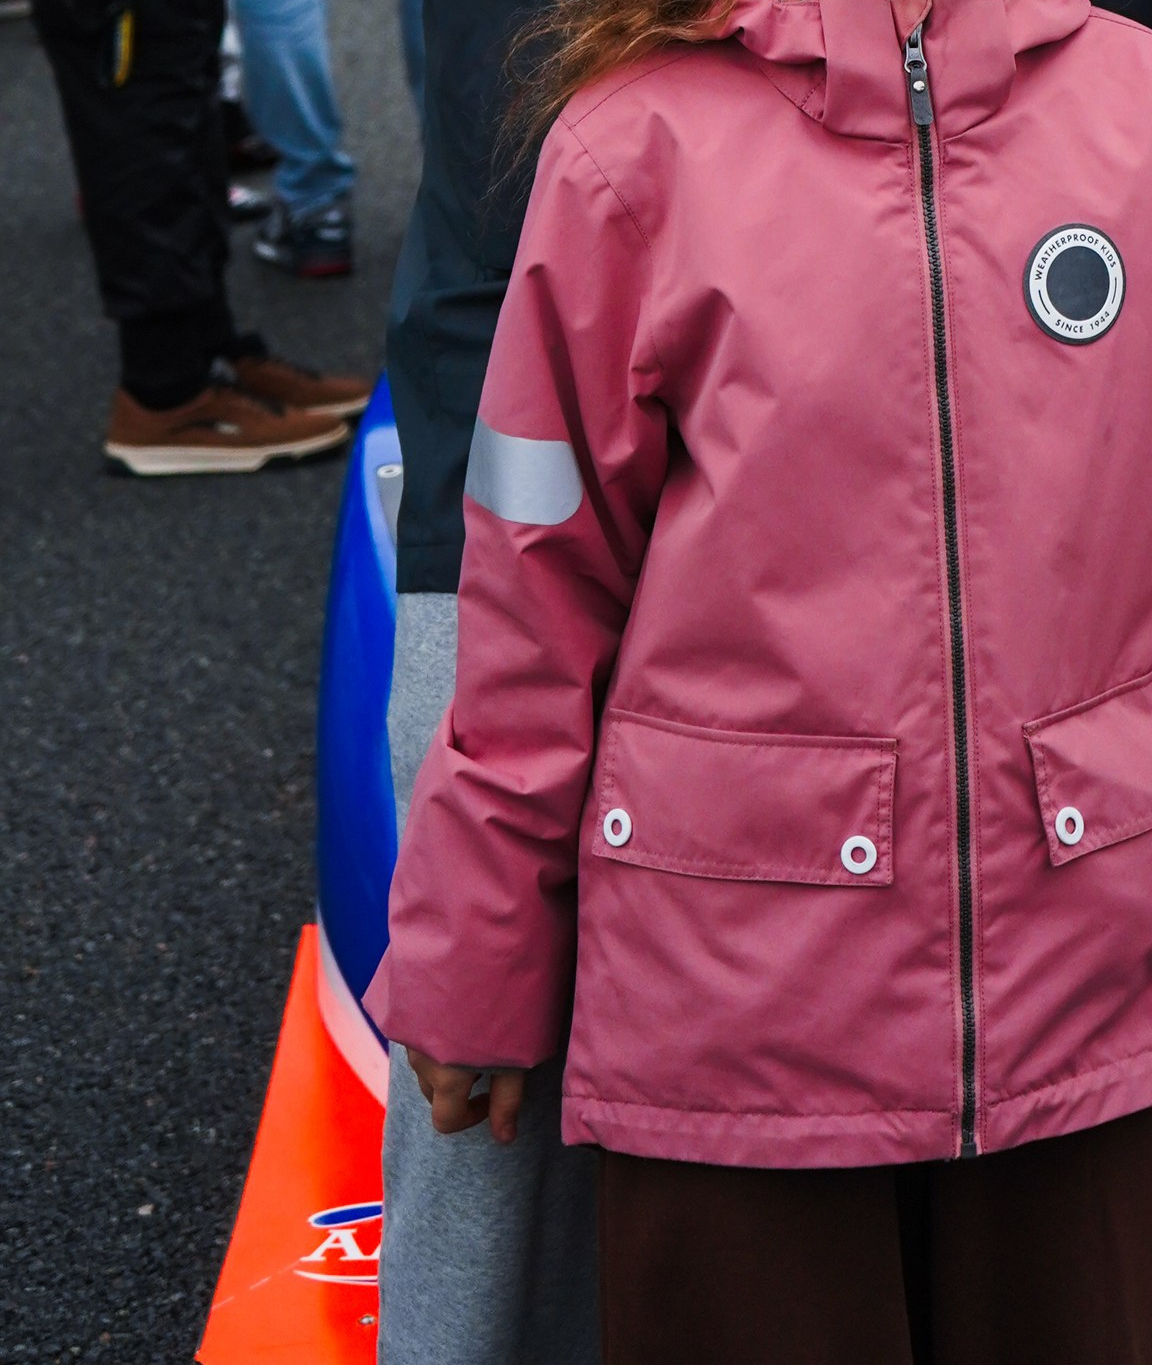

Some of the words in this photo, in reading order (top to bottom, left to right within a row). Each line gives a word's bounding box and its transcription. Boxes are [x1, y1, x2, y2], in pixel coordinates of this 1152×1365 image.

[1034, 233, 1099, 281] WEATHERPROOF
[1100, 244, 1117, 269] KIDS
[1055, 318, 1084, 334] SINCE
[1090, 310, 1110, 331] 1944
